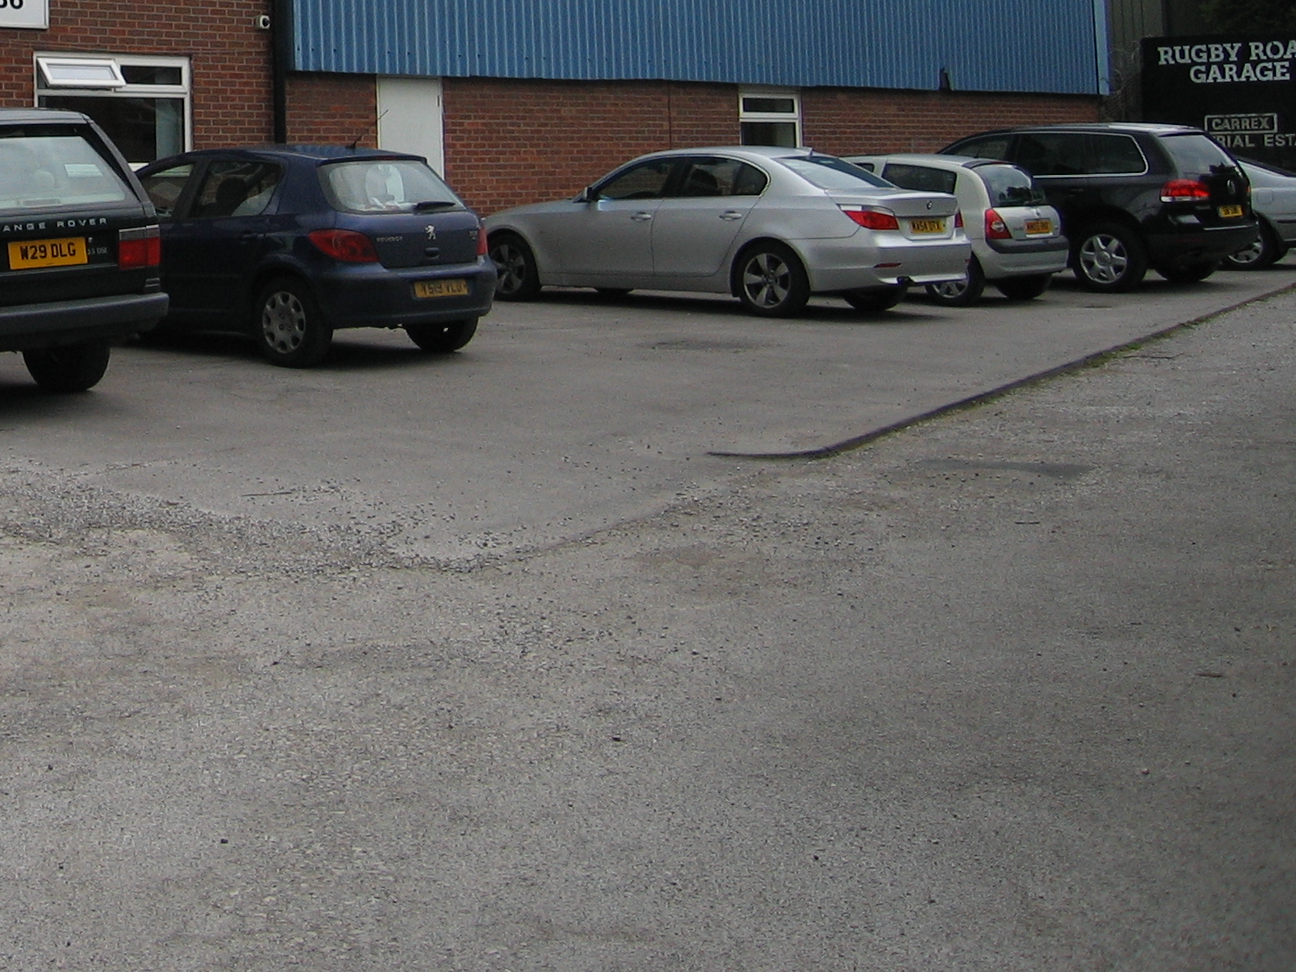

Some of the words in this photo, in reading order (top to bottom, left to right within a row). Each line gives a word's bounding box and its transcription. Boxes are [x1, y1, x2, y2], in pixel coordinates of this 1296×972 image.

[1157, 43, 1242, 65] RUGBY
[1190, 61, 1291, 83] GARAGE
[1212, 117, 1270, 130] CARREX
[1212, 134, 1255, 147] RIAL
[57, 218, 108, 227] ROVER
[20, 244, 47, 260] W29
[51, 242, 76, 258] DLG
